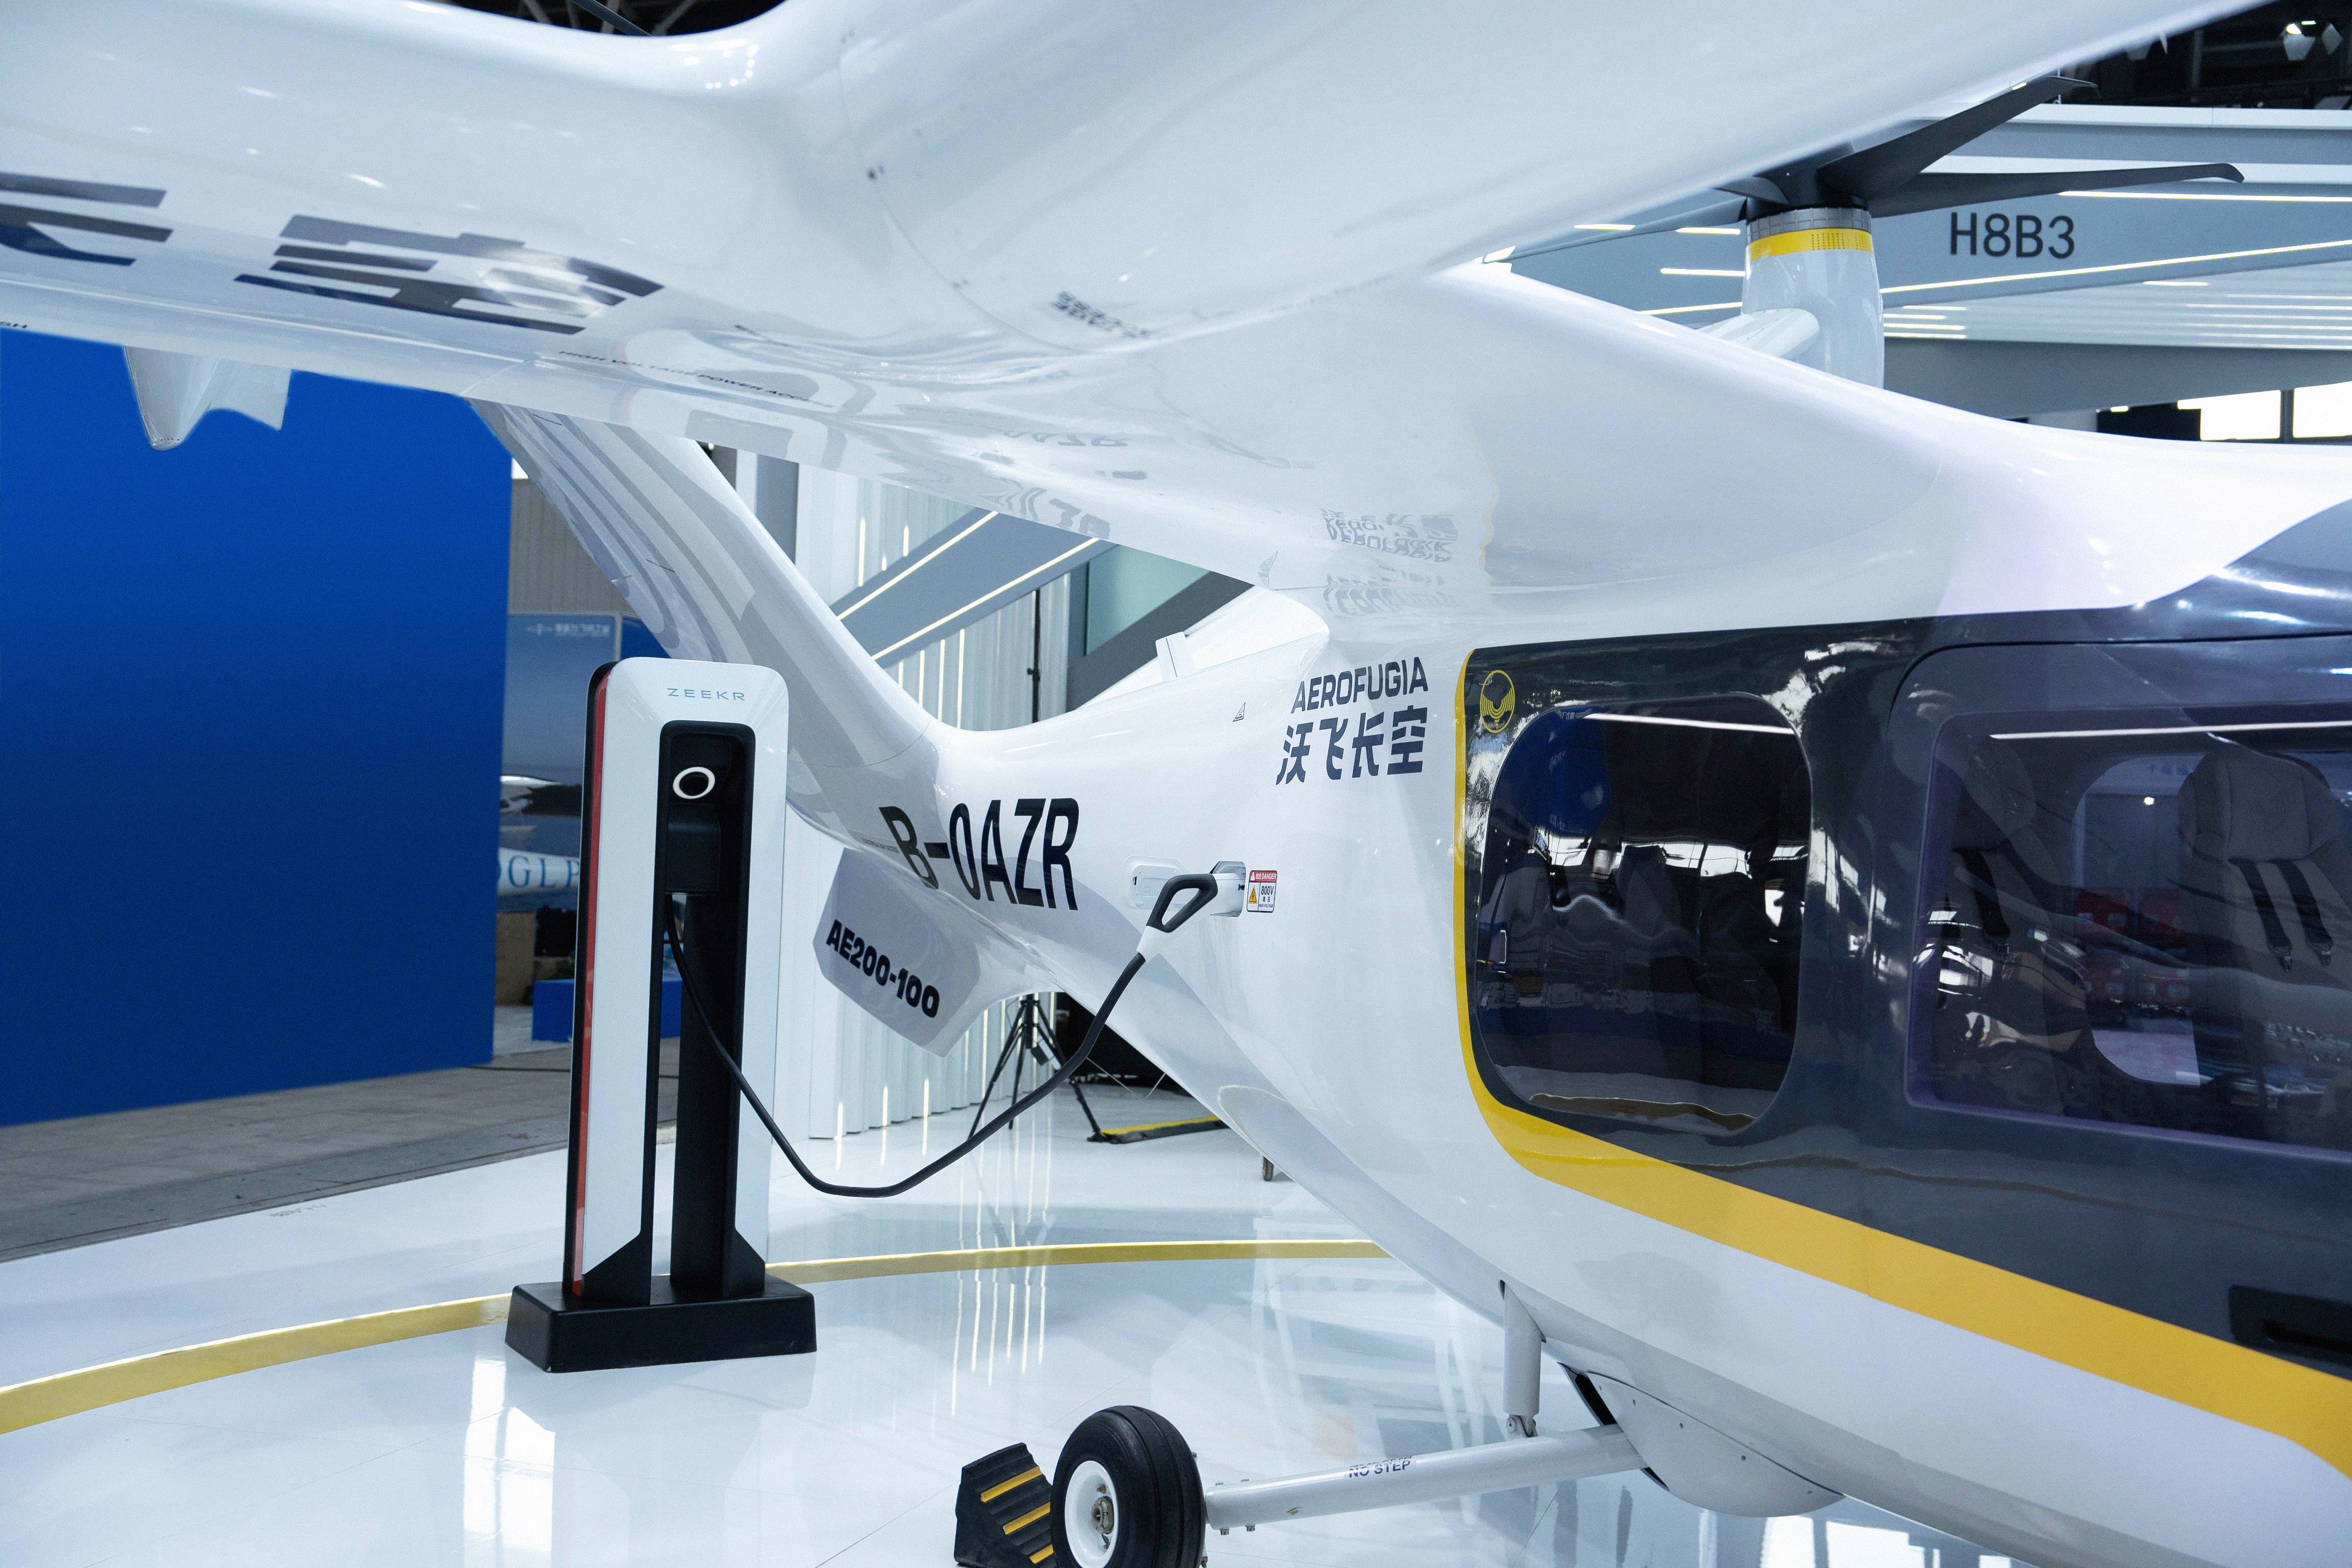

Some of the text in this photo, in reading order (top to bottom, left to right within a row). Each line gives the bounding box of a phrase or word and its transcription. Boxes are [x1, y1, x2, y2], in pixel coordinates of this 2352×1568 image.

[1950, 212, 2075, 259] H8B3
[667, 688, 745, 701] ZEEKR
[1290, 656, 1429, 714] AEROFUGIA
[1276, 705, 1428, 786] 沃飞长空
[1261, 886, 1275, 895] 800V
[825, 919, 940, 1018] AE200-100
[1349, 1459, 1411, 1479] NO STEP
